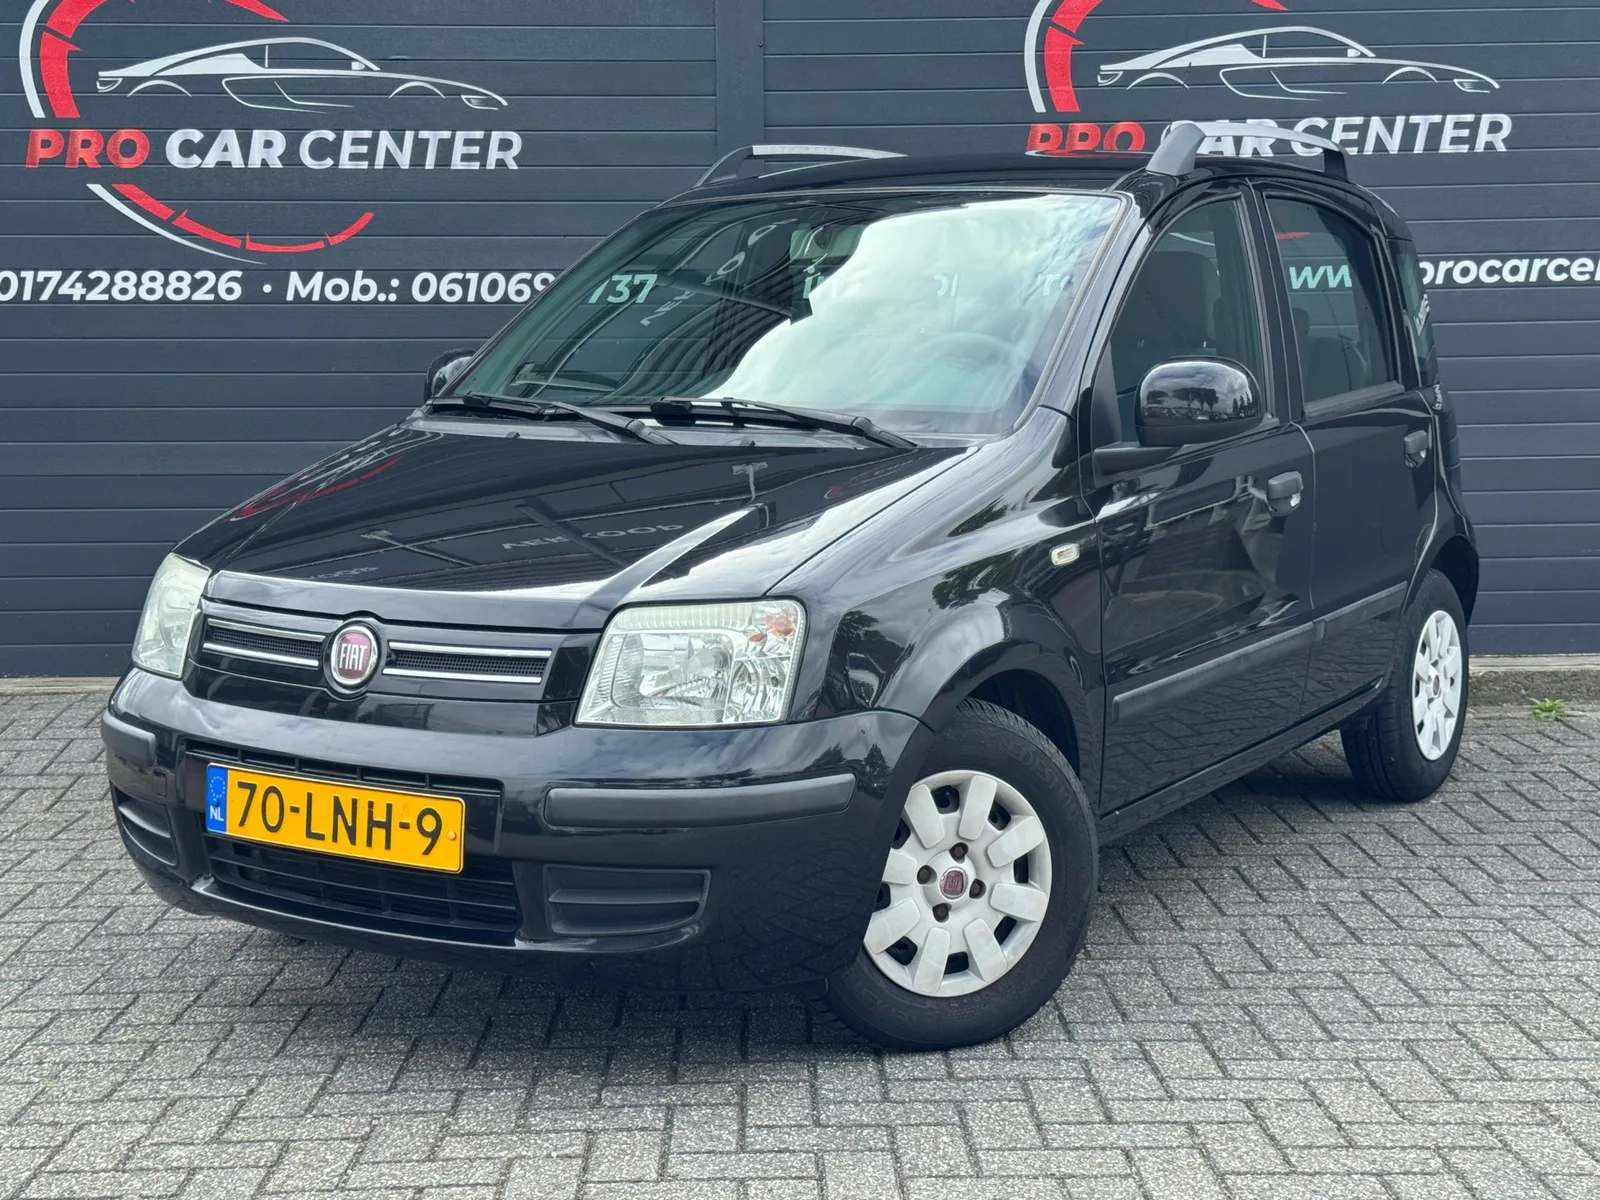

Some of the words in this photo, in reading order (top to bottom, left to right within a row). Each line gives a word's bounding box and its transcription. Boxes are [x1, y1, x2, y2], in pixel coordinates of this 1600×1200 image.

[25, 128, 150, 168] PRO
[165, 128, 287, 168] CAR
[299, 129, 523, 170] CENTER
[1291, 113, 1513, 157] CENTER
[0, 270, 243, 302] 0174288826
[285, 271, 400, 302] Mob.:
[339, 643, 368, 671] FIAT
[209, 805, 224, 822] NL
[237, 781, 443, 856] 70-LNH-9
